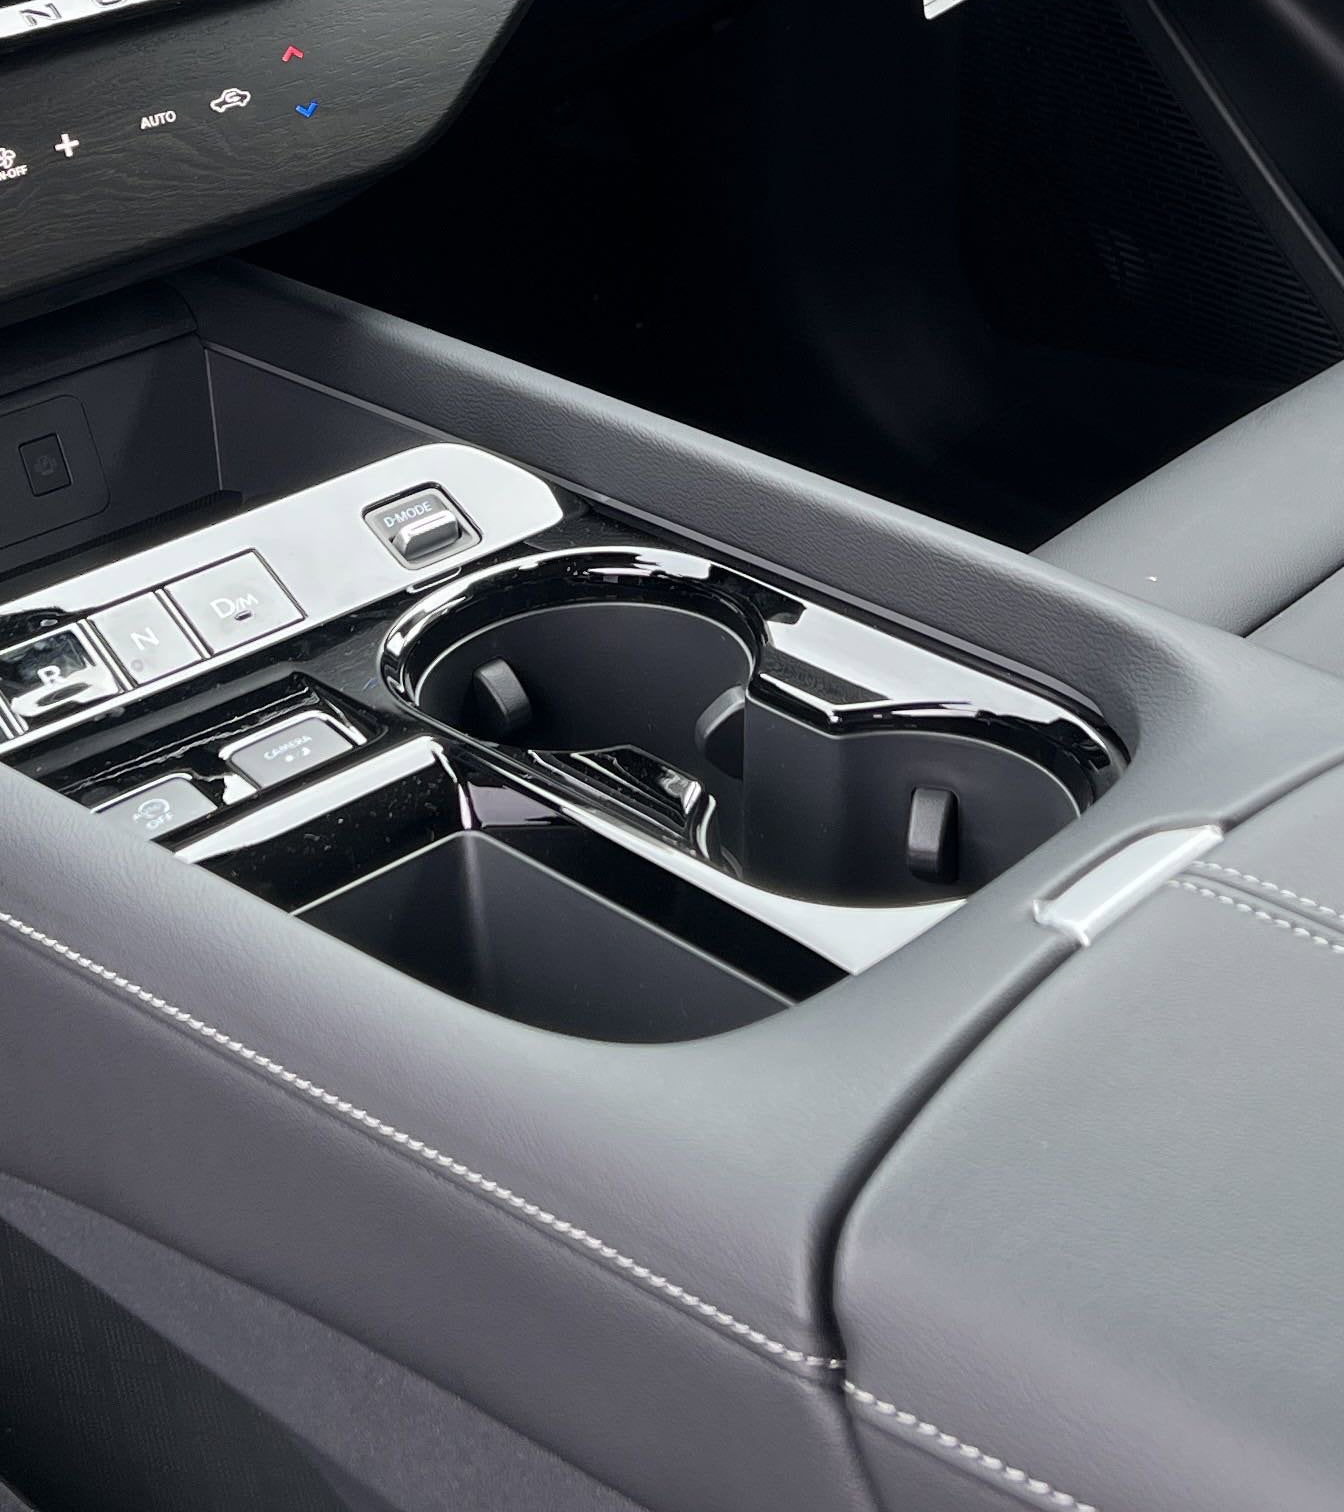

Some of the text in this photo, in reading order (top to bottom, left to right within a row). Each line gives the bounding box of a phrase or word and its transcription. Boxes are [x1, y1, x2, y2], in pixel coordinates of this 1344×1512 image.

[140, 110, 177, 130] AUTO
[130, 626, 160, 651] N
[37, 664, 65, 689] R
